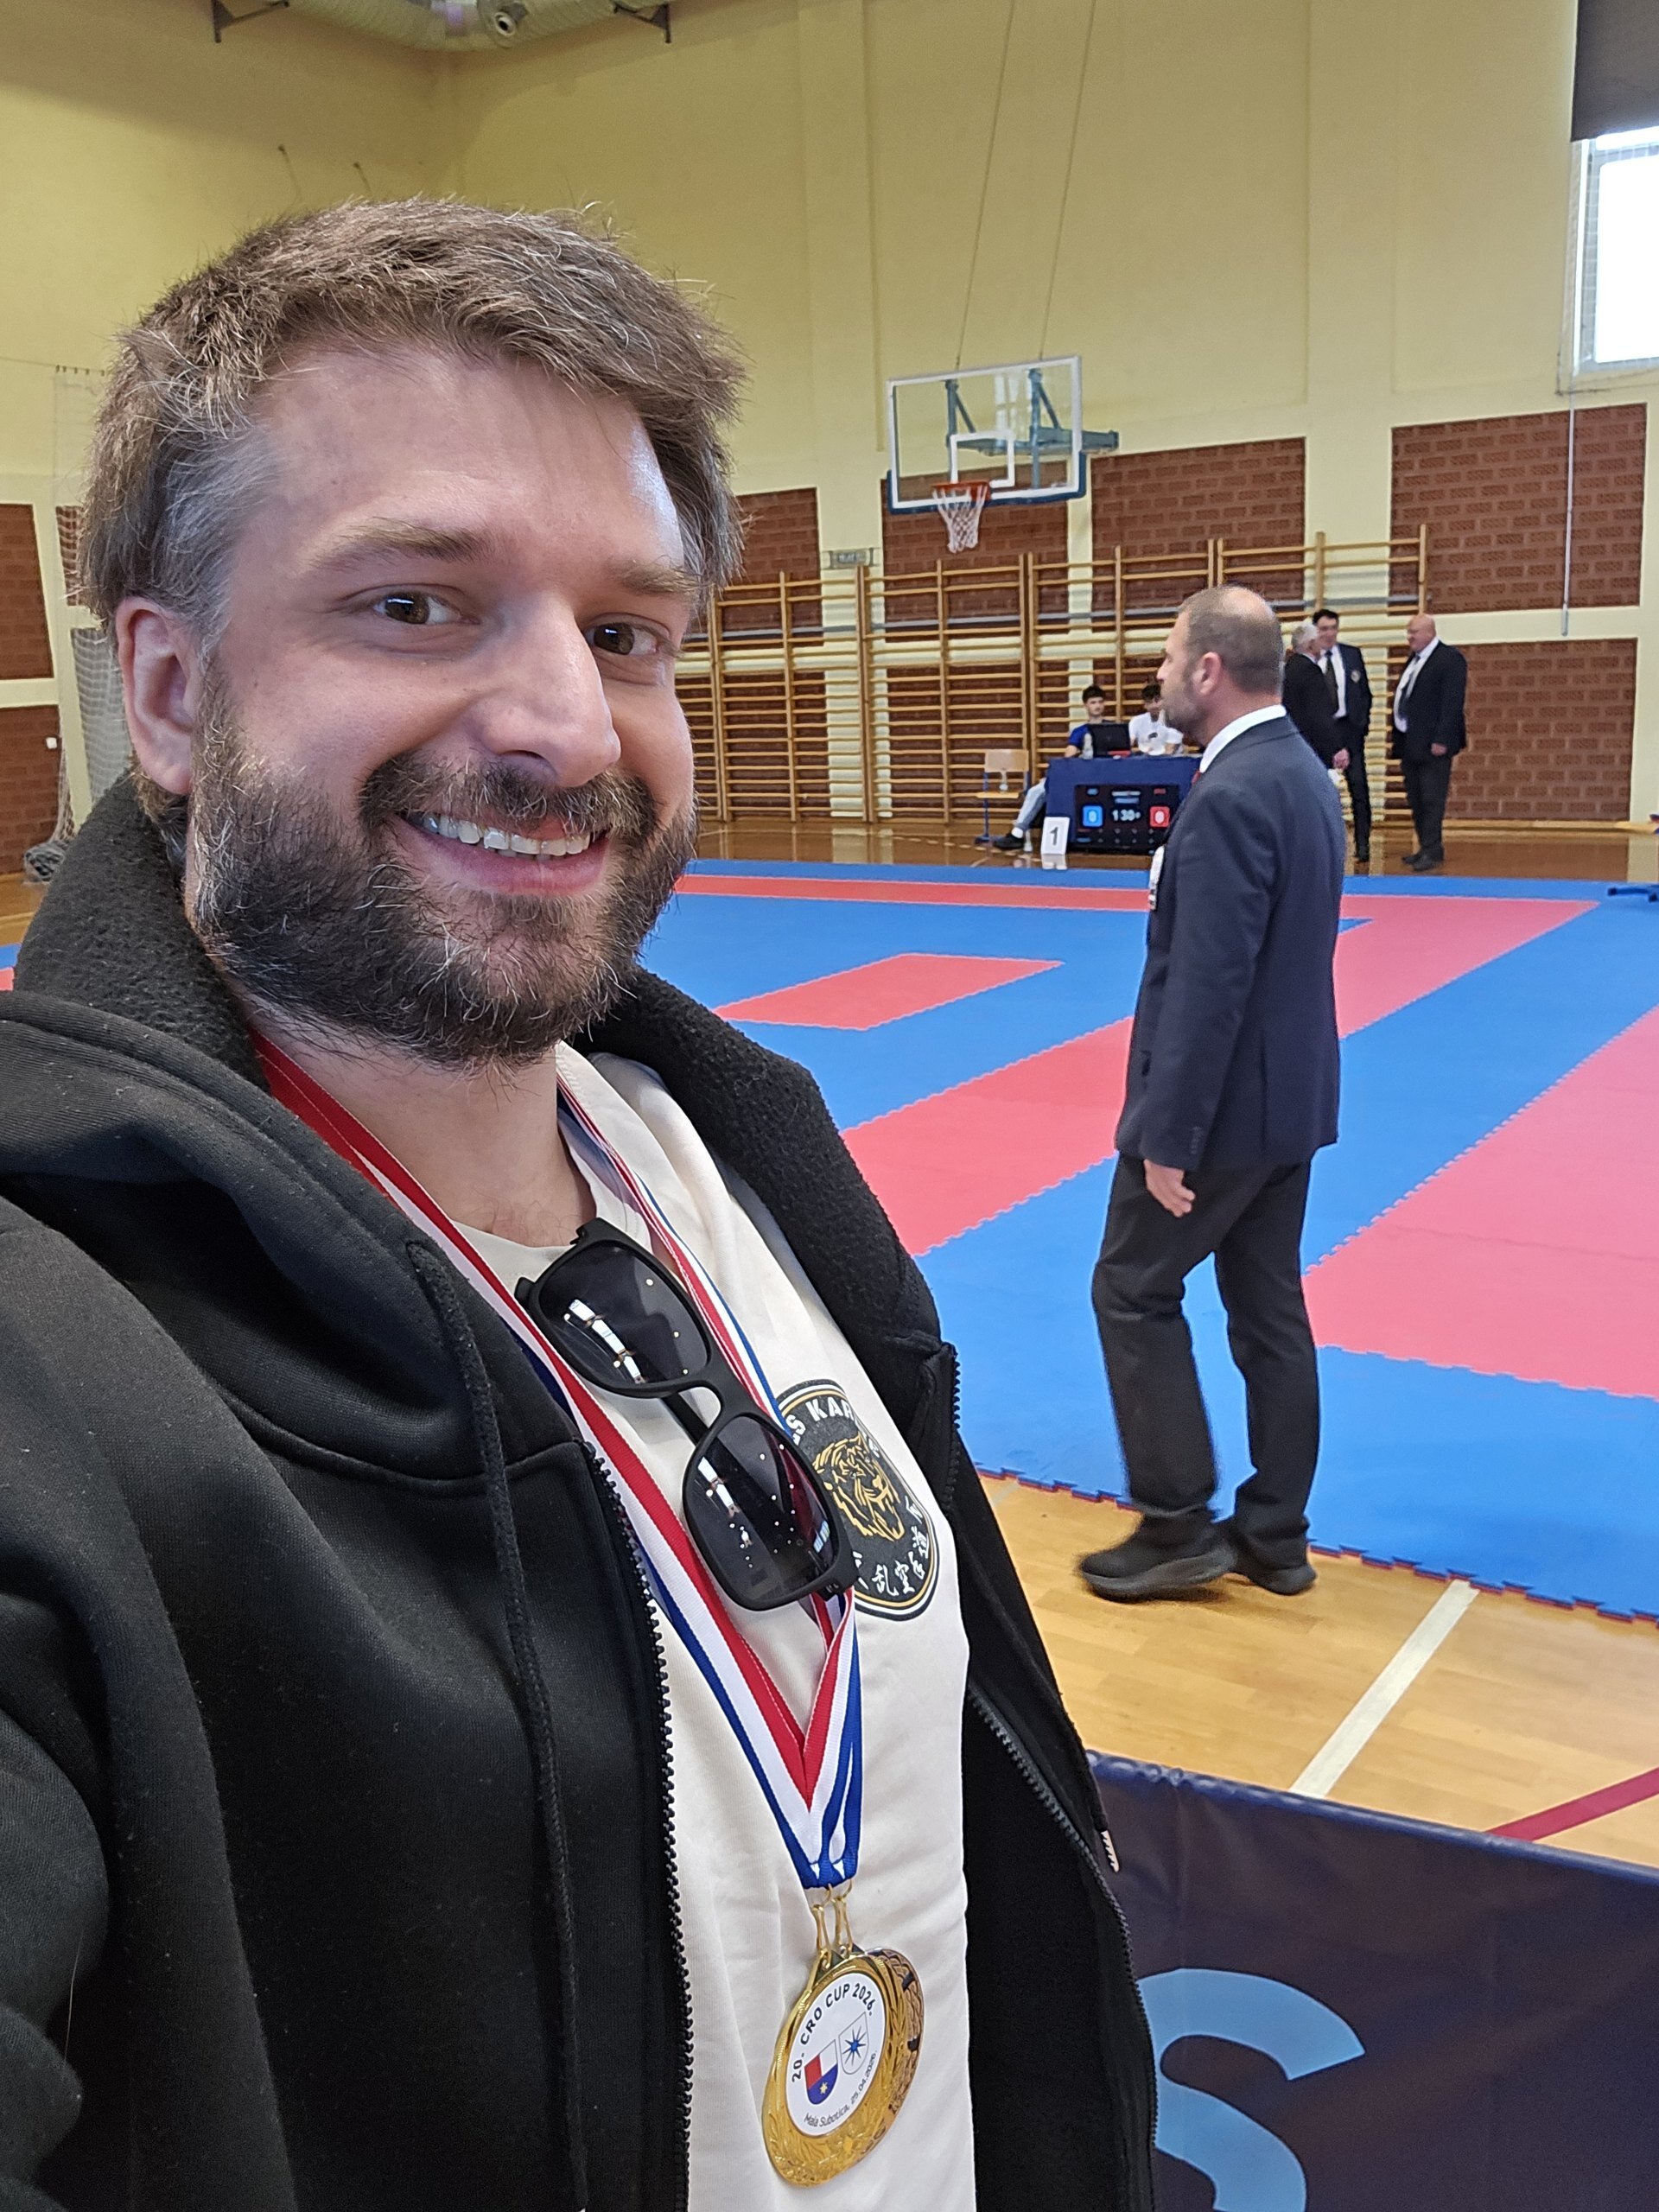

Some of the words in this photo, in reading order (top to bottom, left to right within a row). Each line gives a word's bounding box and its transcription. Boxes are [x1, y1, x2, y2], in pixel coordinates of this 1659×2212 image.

[1154, 810, 1165, 823] 0
[1050, 826, 1058, 846] 1
[800, 2006, 823, 2045] CRO
[825, 1983, 850, 2007] CUP
[852, 1982, 876, 2017] 2026.
